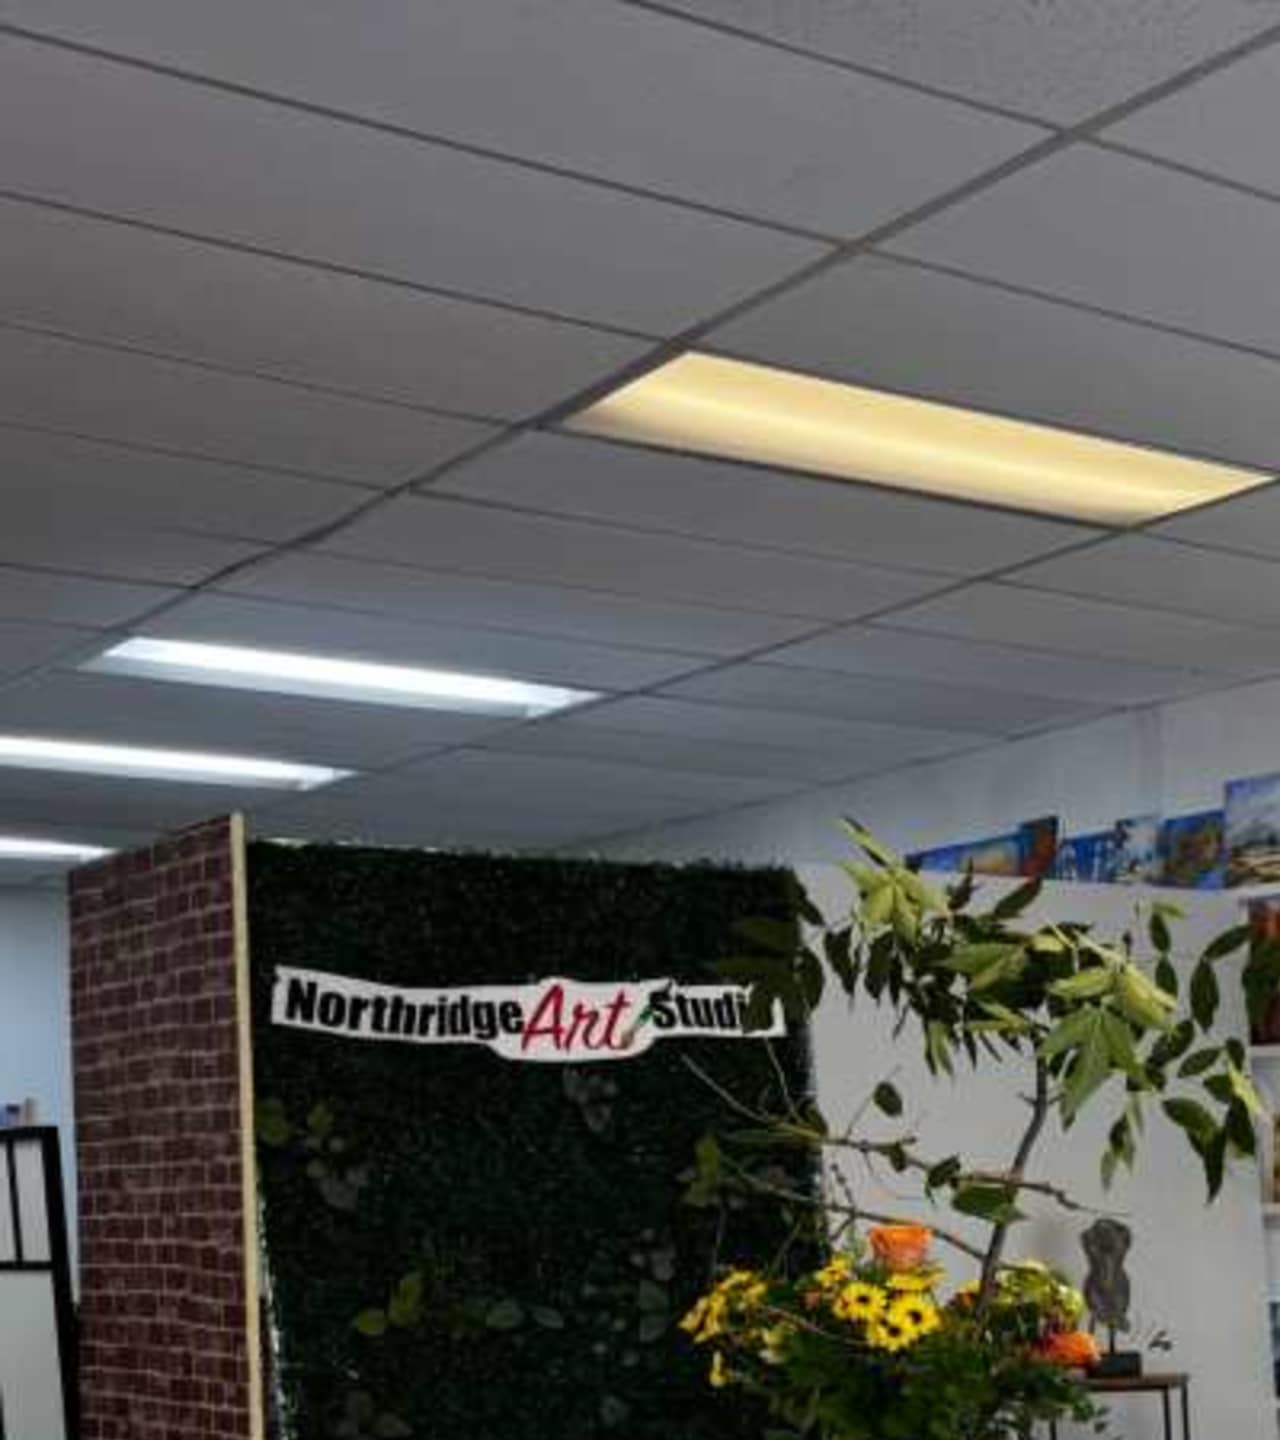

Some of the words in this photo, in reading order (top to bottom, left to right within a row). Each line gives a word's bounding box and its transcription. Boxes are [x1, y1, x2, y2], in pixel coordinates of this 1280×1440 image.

[285, 977, 525, 1041] Northridge
[520, 983, 634, 1052] Art
[648, 990, 766, 1030] Studi
